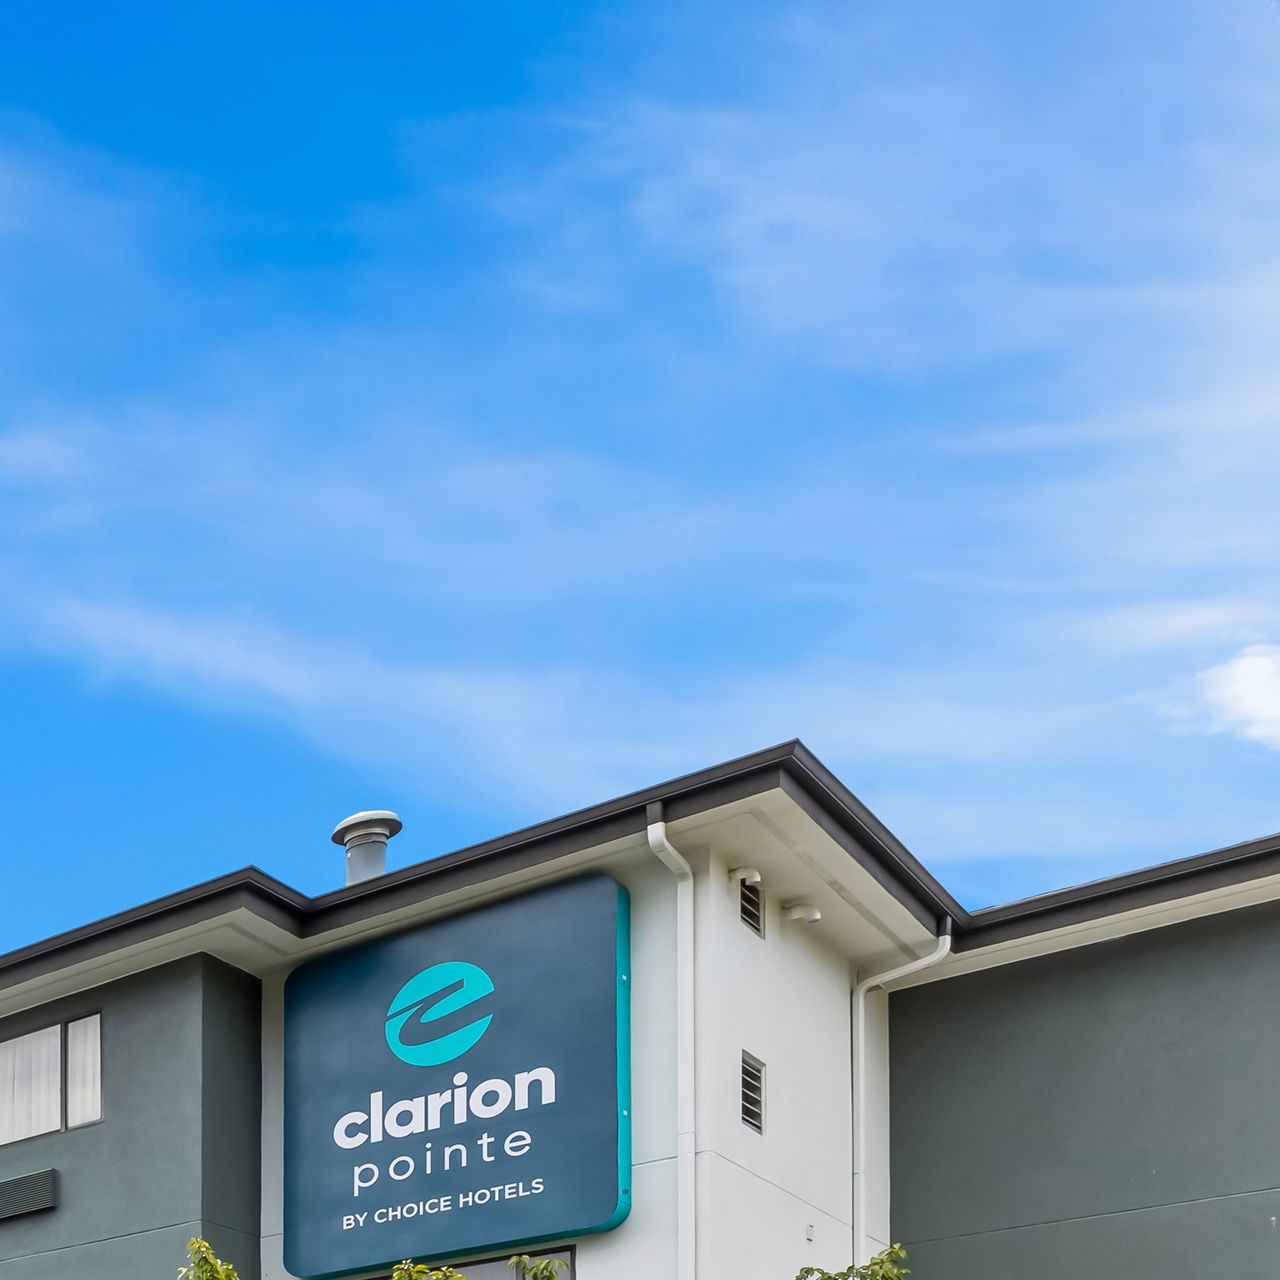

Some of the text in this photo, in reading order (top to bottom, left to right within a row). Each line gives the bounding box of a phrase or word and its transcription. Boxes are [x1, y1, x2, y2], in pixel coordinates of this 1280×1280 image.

[333, 1066, 556, 1149] clarion
[353, 1130, 532, 1197] pointe
[342, 1178, 544, 1230] BY CHOICE HOTELS
